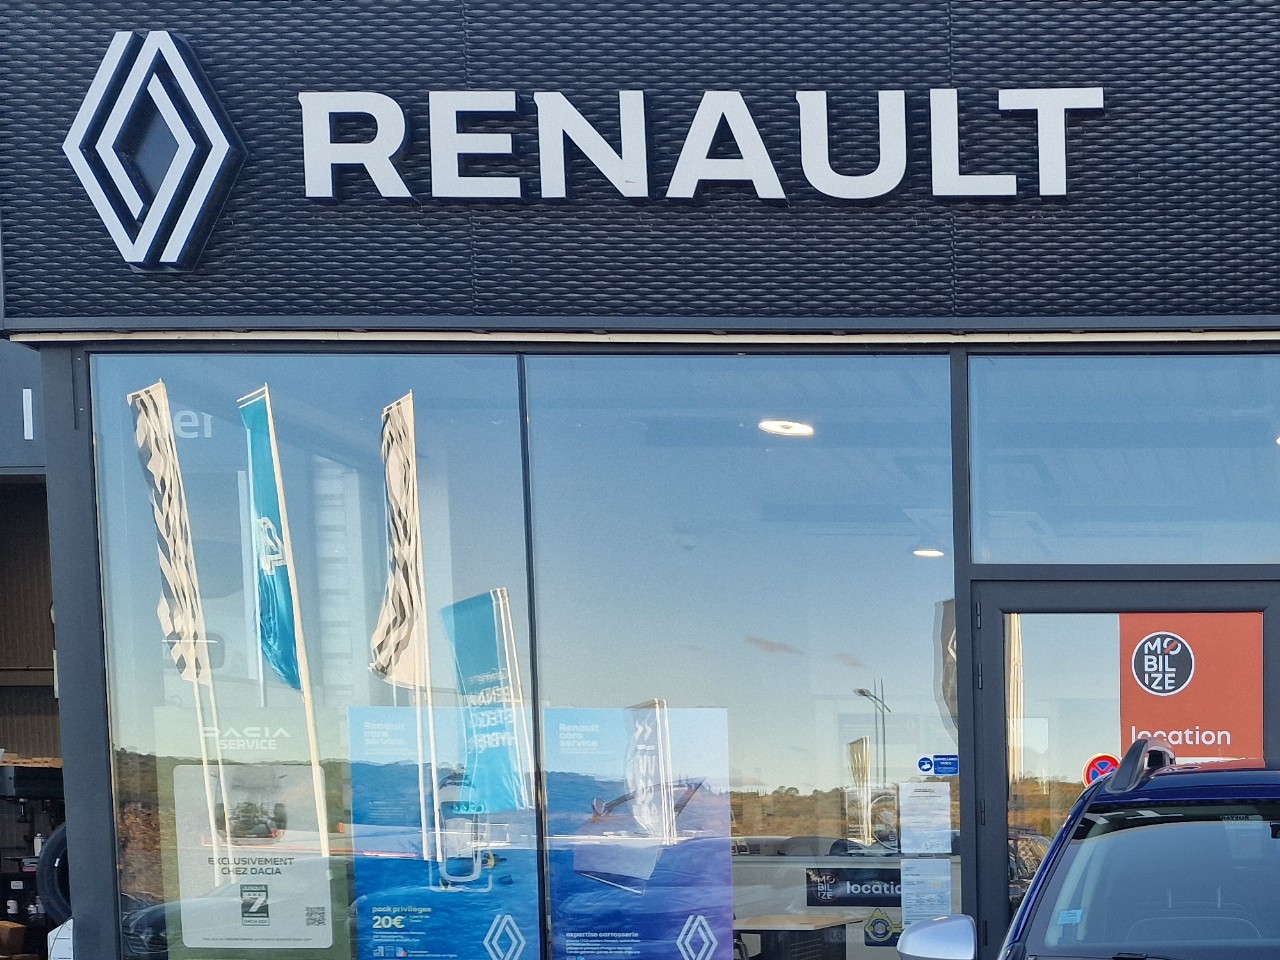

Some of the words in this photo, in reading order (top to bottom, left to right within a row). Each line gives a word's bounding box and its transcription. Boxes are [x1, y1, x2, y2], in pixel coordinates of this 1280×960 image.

[298, 87, 1104, 198] RENAULT
[219, 739, 277, 750] SERVICE
[207, 857, 295, 866] EXCLUSIVEMENT
[221, 867, 249, 875] CHEZ
[250, 867, 282, 875] DACIA
[846, 880, 901, 894] locatio
[372, 905, 392, 914] pack
[372, 915, 406, 929] 20€
